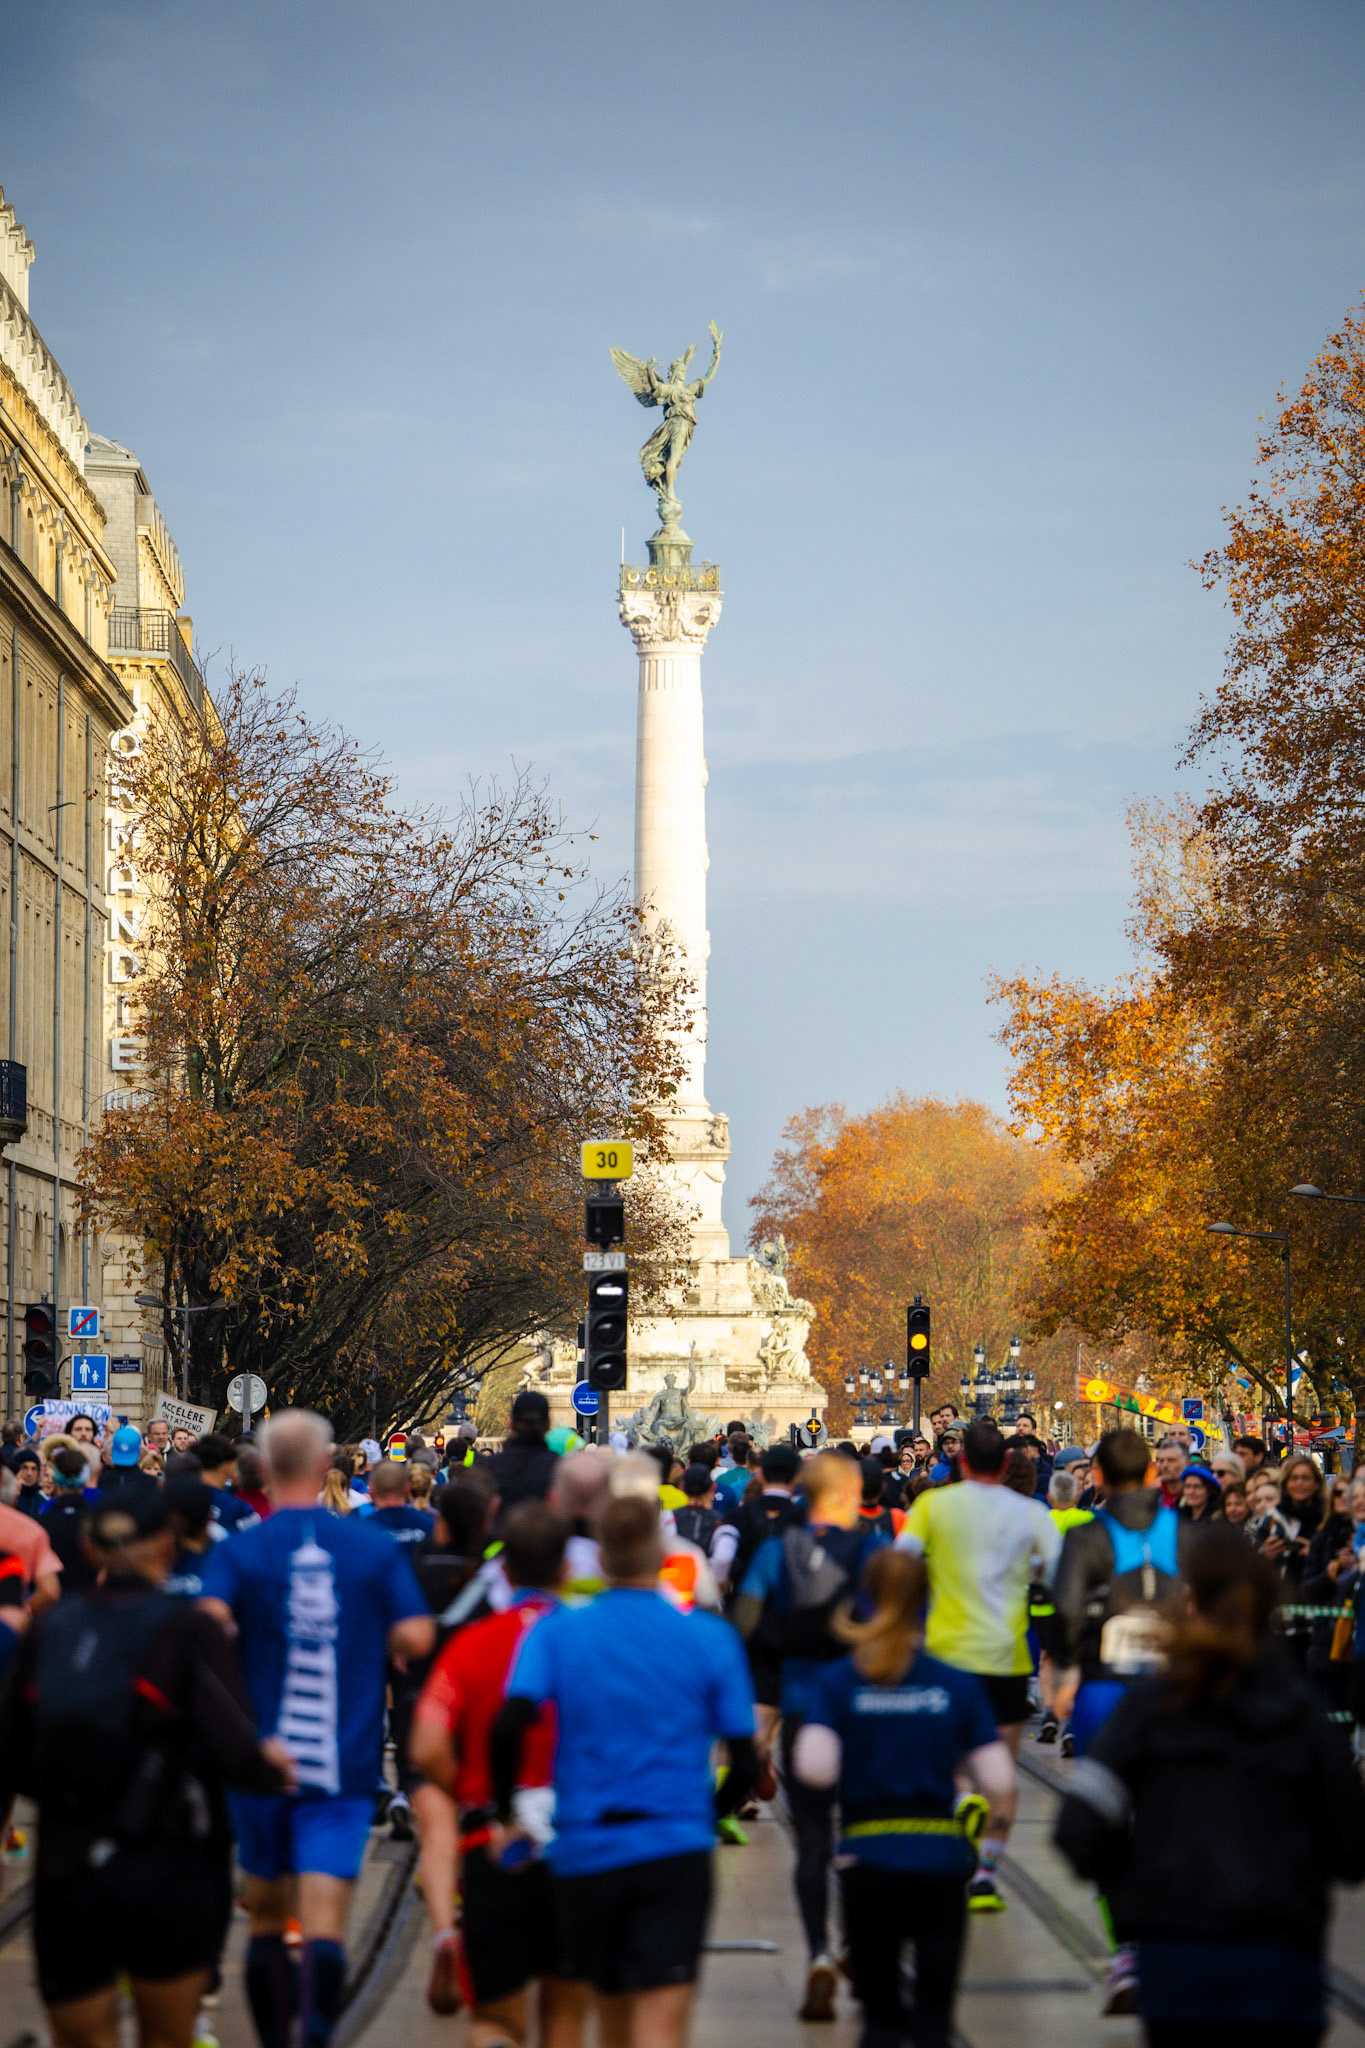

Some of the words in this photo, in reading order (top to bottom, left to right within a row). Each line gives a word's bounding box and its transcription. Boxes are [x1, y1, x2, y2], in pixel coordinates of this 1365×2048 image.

[596, 1152, 618, 1168] 30
[586, 1254, 604, 1269] 123
[161, 1400, 206, 1424] ACCÉLÈRE
